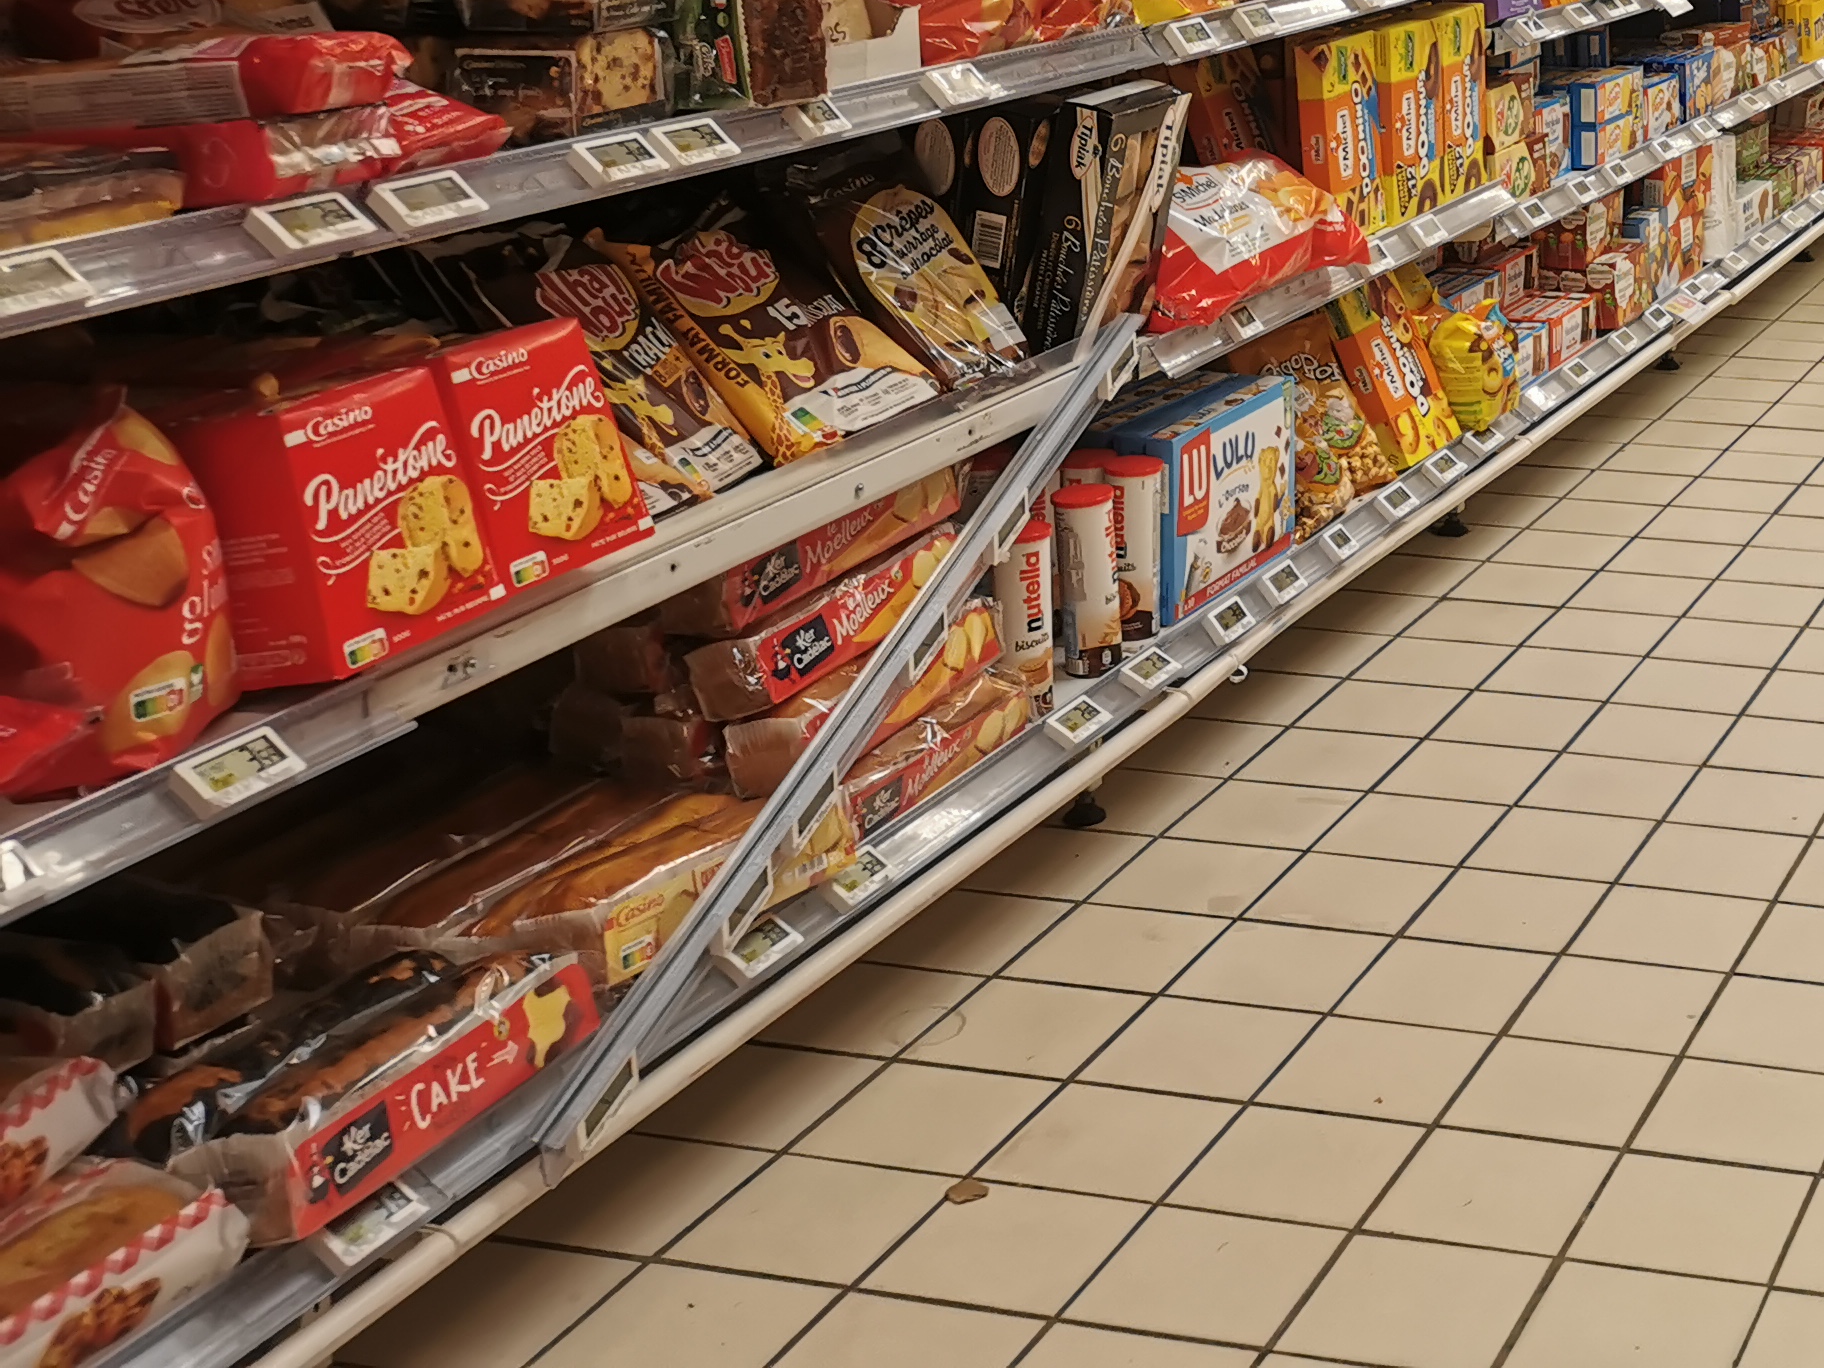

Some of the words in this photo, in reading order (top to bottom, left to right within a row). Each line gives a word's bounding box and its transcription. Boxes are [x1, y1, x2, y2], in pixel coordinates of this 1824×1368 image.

[1073, 123, 1094, 171] Tipiak
[1110, 133, 1127, 152] 6
[1153, 120, 1174, 197] Tipiak
[1096, 157, 1123, 238] Bouchées
[856, 237, 886, 269] 8
[872, 199, 935, 248] Crêpes
[1063, 215, 1081, 232] 6
[1053, 230, 1081, 289] Bouchées
[766, 298, 808, 331] 15
[470, 348, 528, 379] Casino
[1381, 317, 1430, 417] DOONUTS
[305, 406, 373, 441] Casino
[471, 364, 604, 461] Panettone
[304, 421, 457, 531] Panettone
[1183, 445, 1208, 508] LU
[1213, 431, 1257, 480] LULU
[1217, 483, 1250, 509] L'Ourson
[766, 554, 786, 575] Ker
[805, 511, 874, 573] Moelleux
[760, 561, 800, 596] Cadélac
[1020, 550, 1045, 634] nutella
[1206, 574, 1230, 597] FORMAT
[1229, 557, 1257, 583] FAMILIAL
[832, 581, 895, 645] Moelleux
[794, 634, 832, 670] Cadélac
[796, 627, 816, 649] Ker
[1014, 632, 1051, 652] biscuits
[410, 1051, 487, 1130] CAKE
[340, 1123, 372, 1155] Ker
